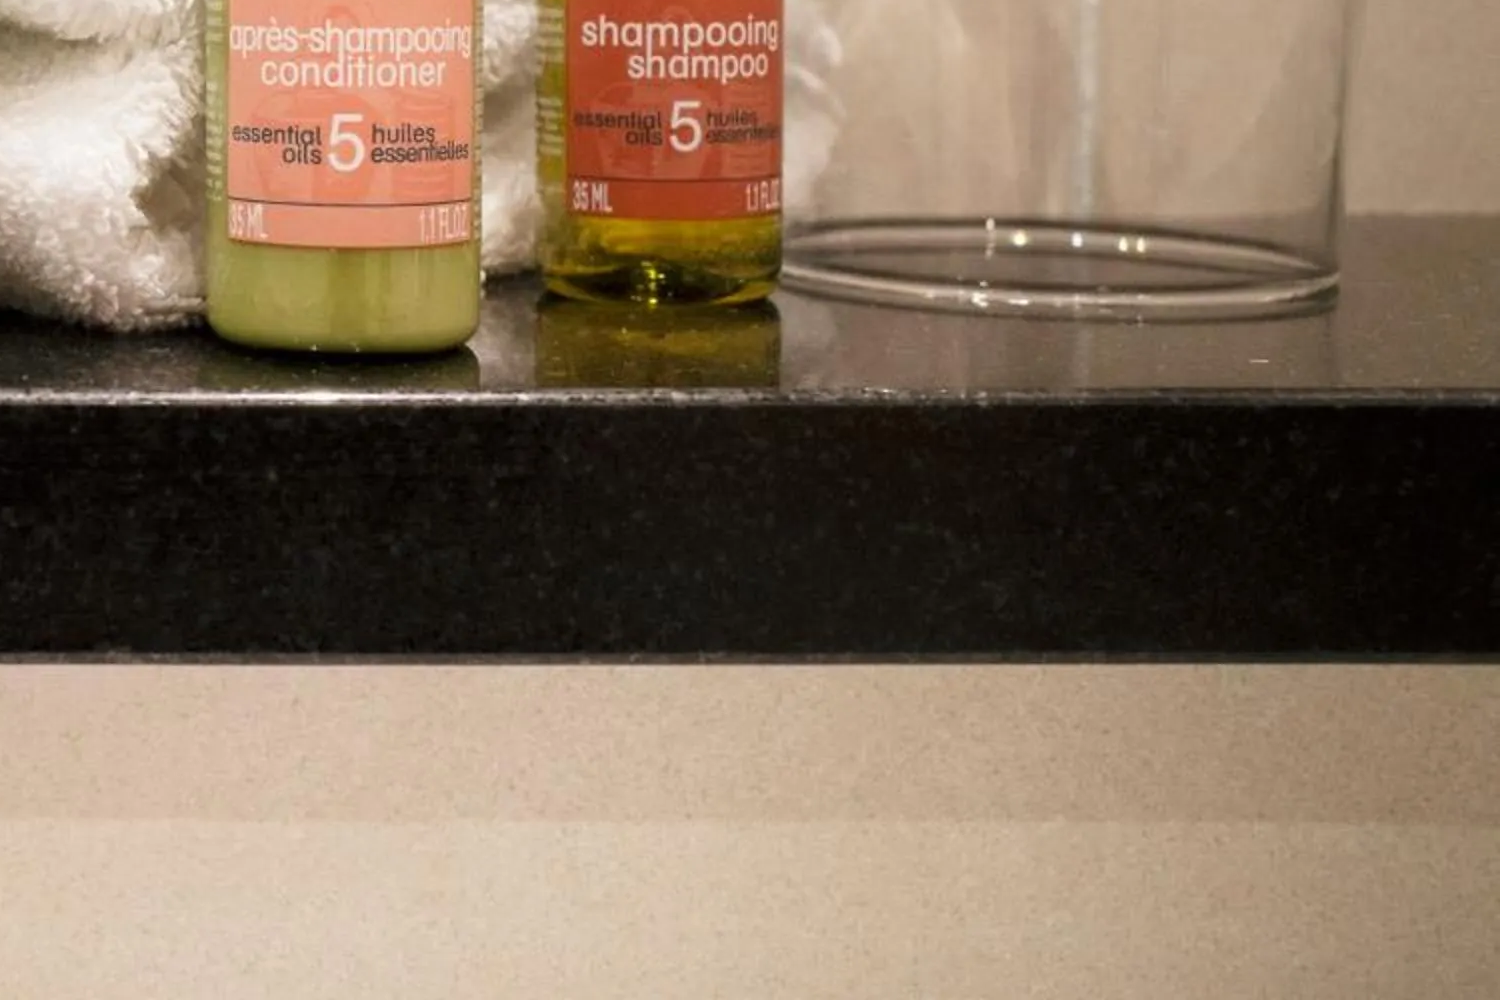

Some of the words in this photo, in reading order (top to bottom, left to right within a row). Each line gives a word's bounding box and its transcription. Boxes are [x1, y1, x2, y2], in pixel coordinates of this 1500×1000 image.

[229, 17, 471, 58] après-shampooing
[581, 14, 779, 53] shampooing
[260, 55, 446, 88] conditioner
[627, 48, 769, 84] shampoo
[573, 110, 662, 130] essential
[669, 100, 702, 152] 5
[706, 108, 759, 127] huiles
[232, 124, 322, 145] essential
[327, 112, 365, 172] 5
[371, 123, 436, 144] huiles
[625, 128, 663, 146] oils
[281, 145, 322, 165] oils
[371, 142, 469, 164] essentielles
[591, 182, 613, 213] ML
